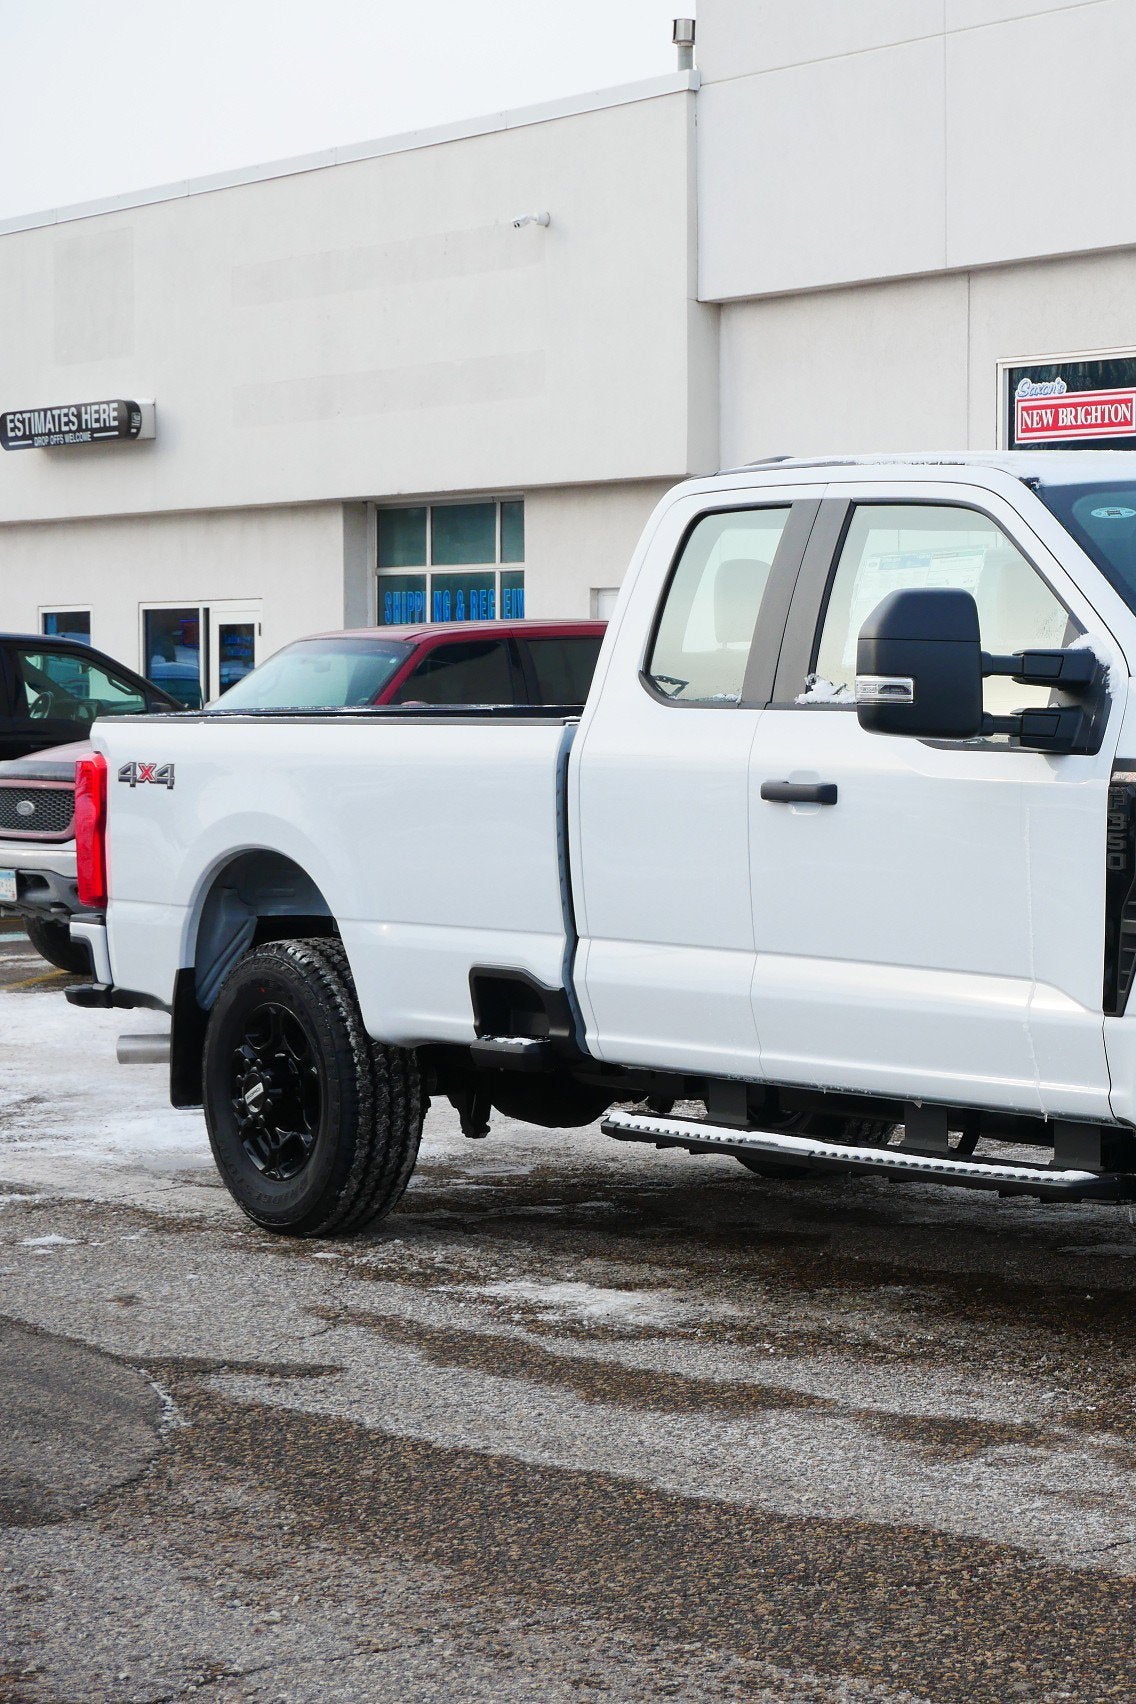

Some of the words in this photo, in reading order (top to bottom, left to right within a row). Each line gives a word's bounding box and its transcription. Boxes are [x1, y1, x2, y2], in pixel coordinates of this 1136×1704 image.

[1017, 378, 1066, 397] Saxon's
[6, 407, 78, 437] ESTIMATES
[82, 403, 119, 429] HERE
[1021, 409, 1055, 428] NEW
[1057, 403, 1132, 426] BRIGHTON
[34, 435, 49, 446] DROP
[50, 434, 64, 445] OFFS
[64, 432, 92, 443] WELCOME
[456, 590, 465, 622] &
[118, 762, 175, 789] 4x4
